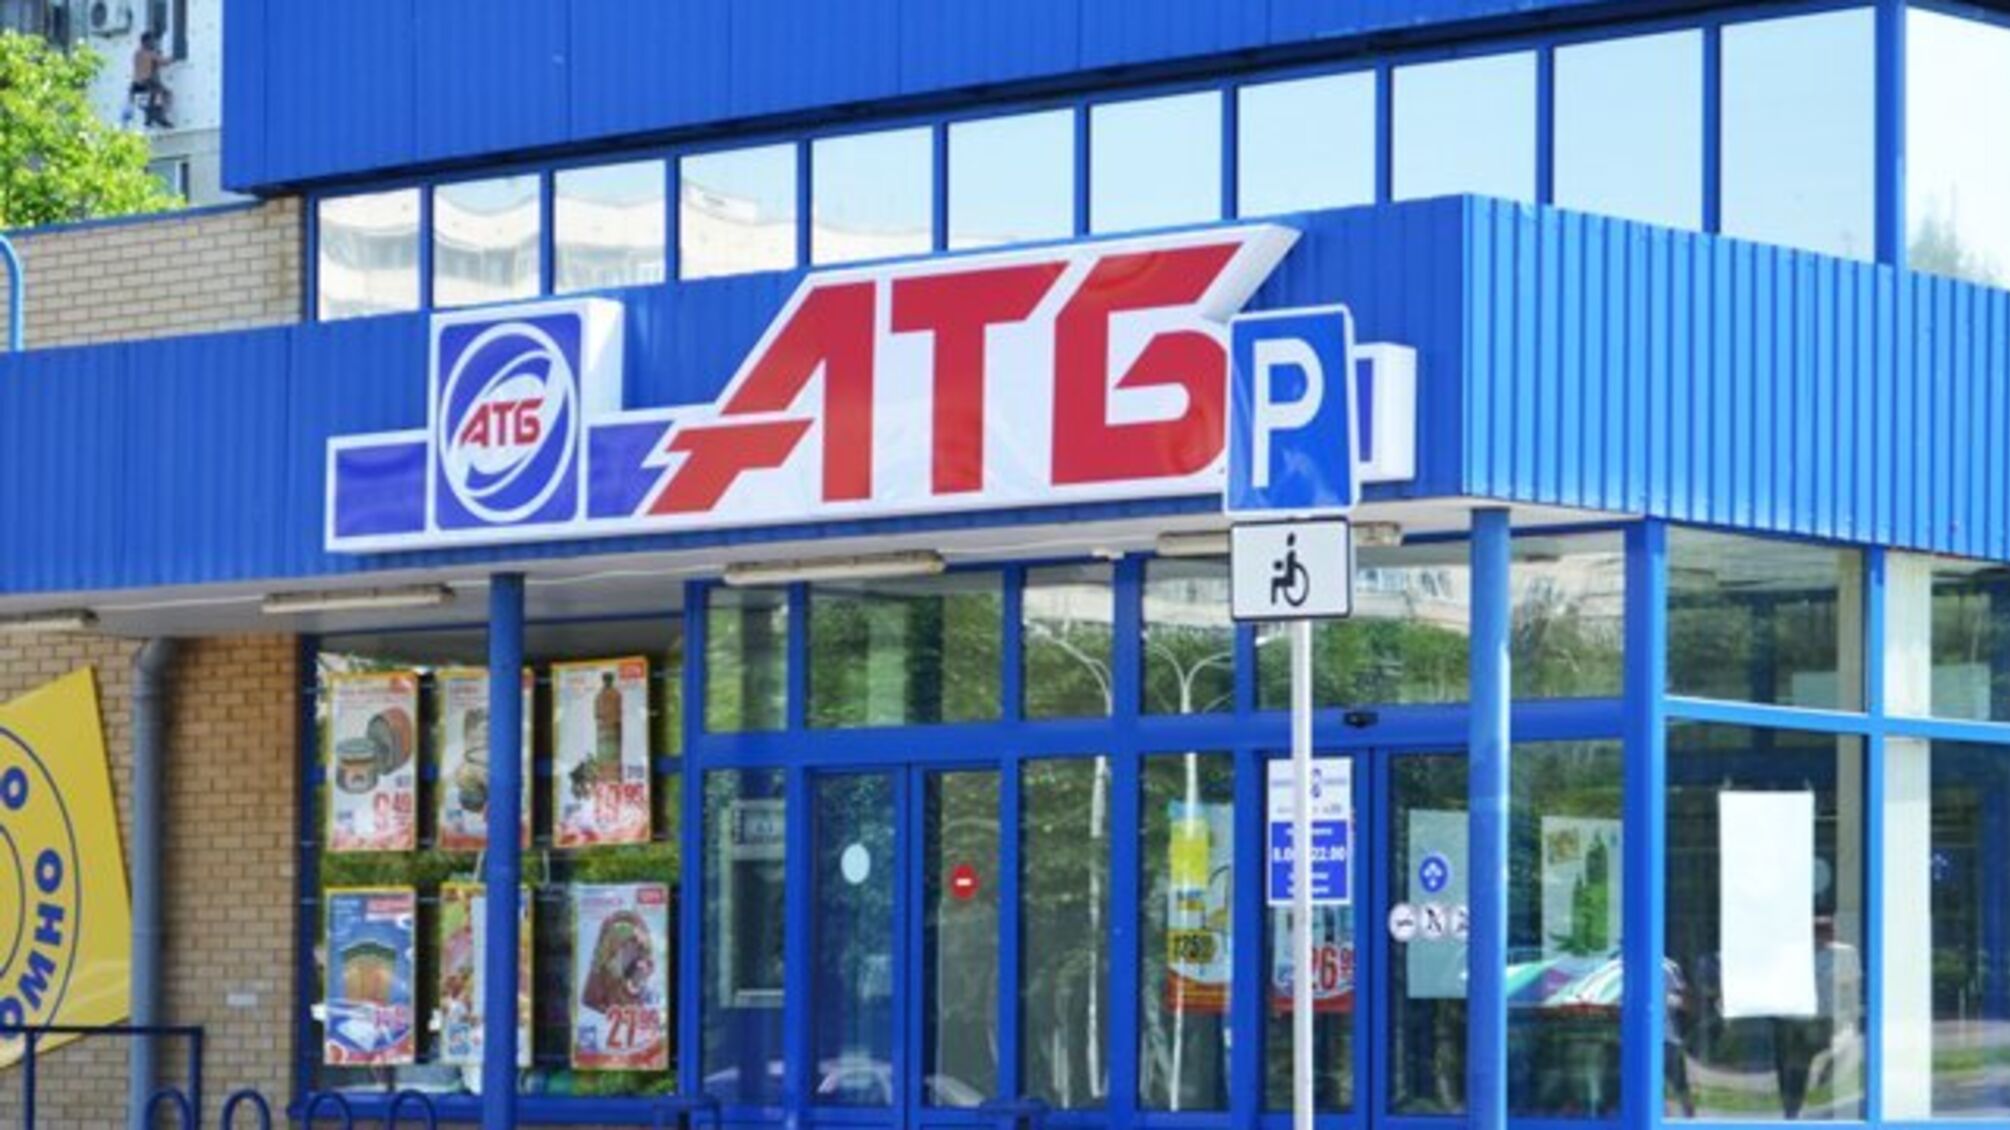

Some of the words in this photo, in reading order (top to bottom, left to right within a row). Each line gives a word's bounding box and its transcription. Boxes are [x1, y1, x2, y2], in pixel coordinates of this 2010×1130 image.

[459, 398, 544, 447] АТБ
[646, 241, 1243, 516] АТБ
[1252, 338, 1324, 488] P
